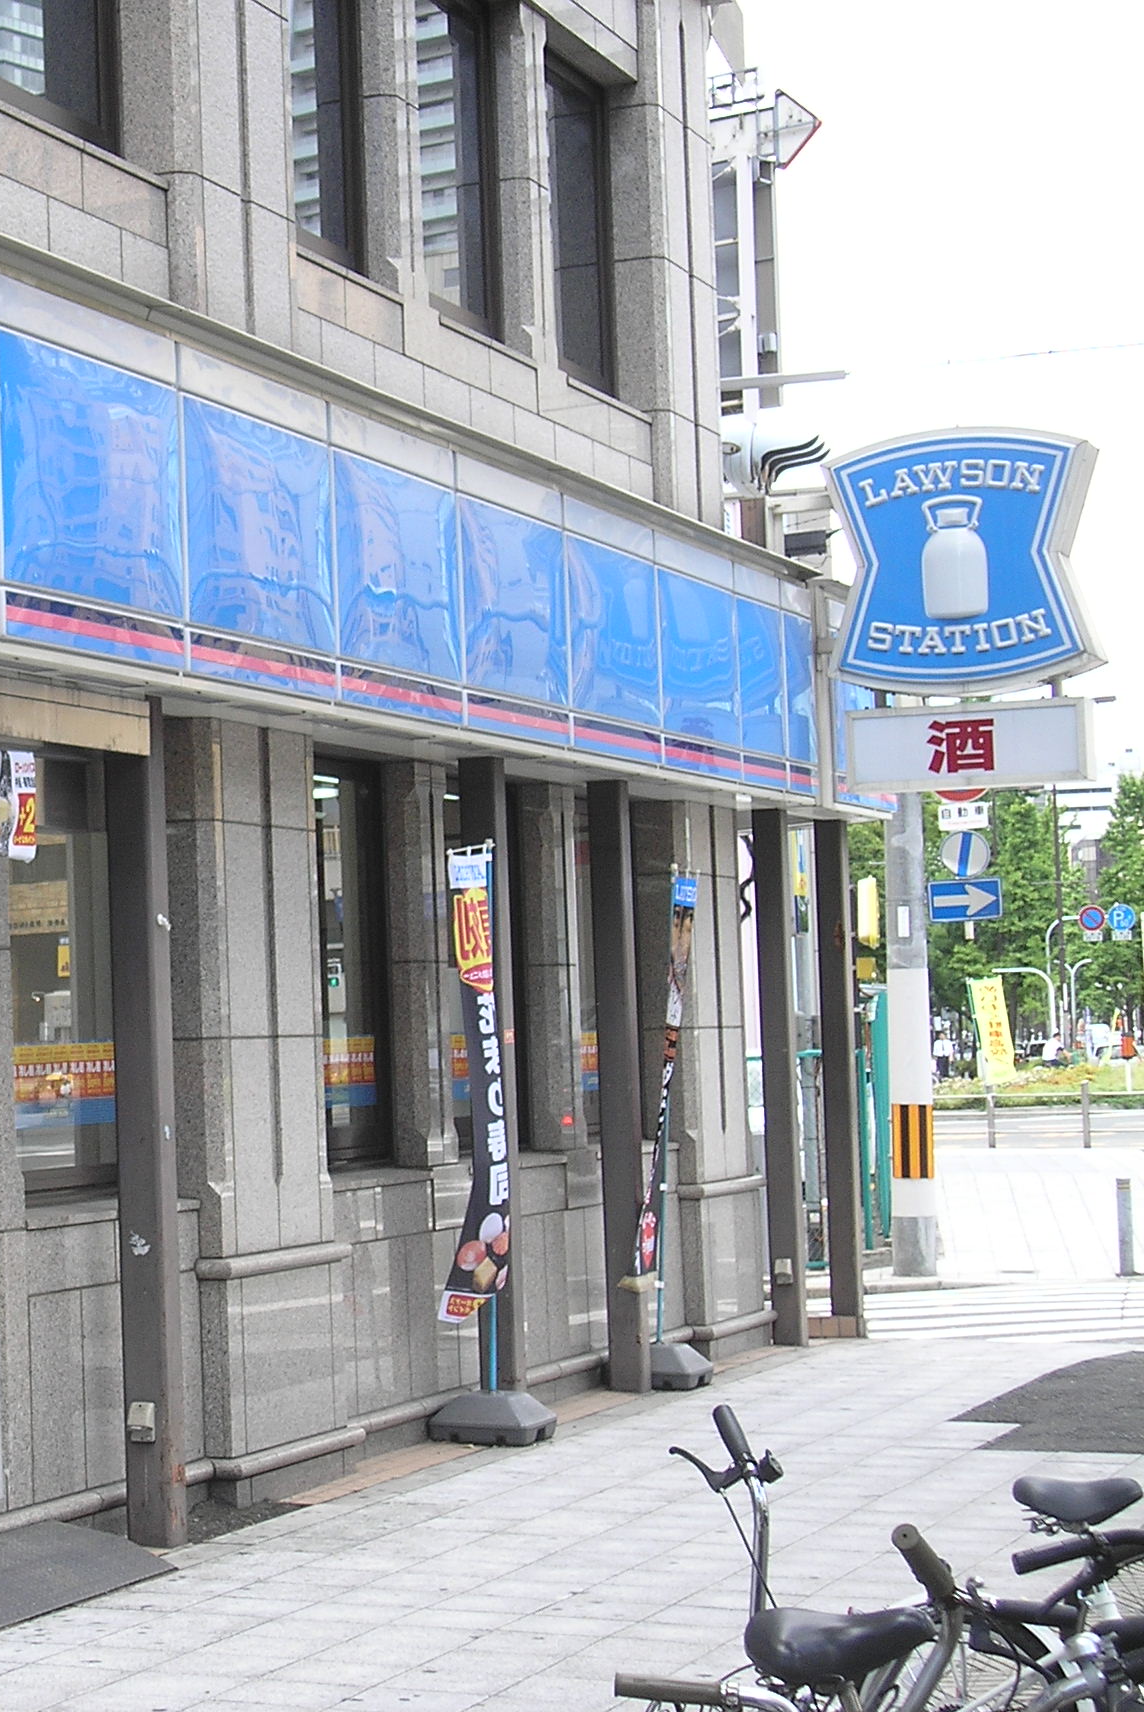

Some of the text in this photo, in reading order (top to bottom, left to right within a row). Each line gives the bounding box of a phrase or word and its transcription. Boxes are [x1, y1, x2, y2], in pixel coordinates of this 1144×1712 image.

[858, 459, 1045, 507] LAWSON
[867, 608, 1052, 654] STATION
[926, 717, 995, 774] 酒
